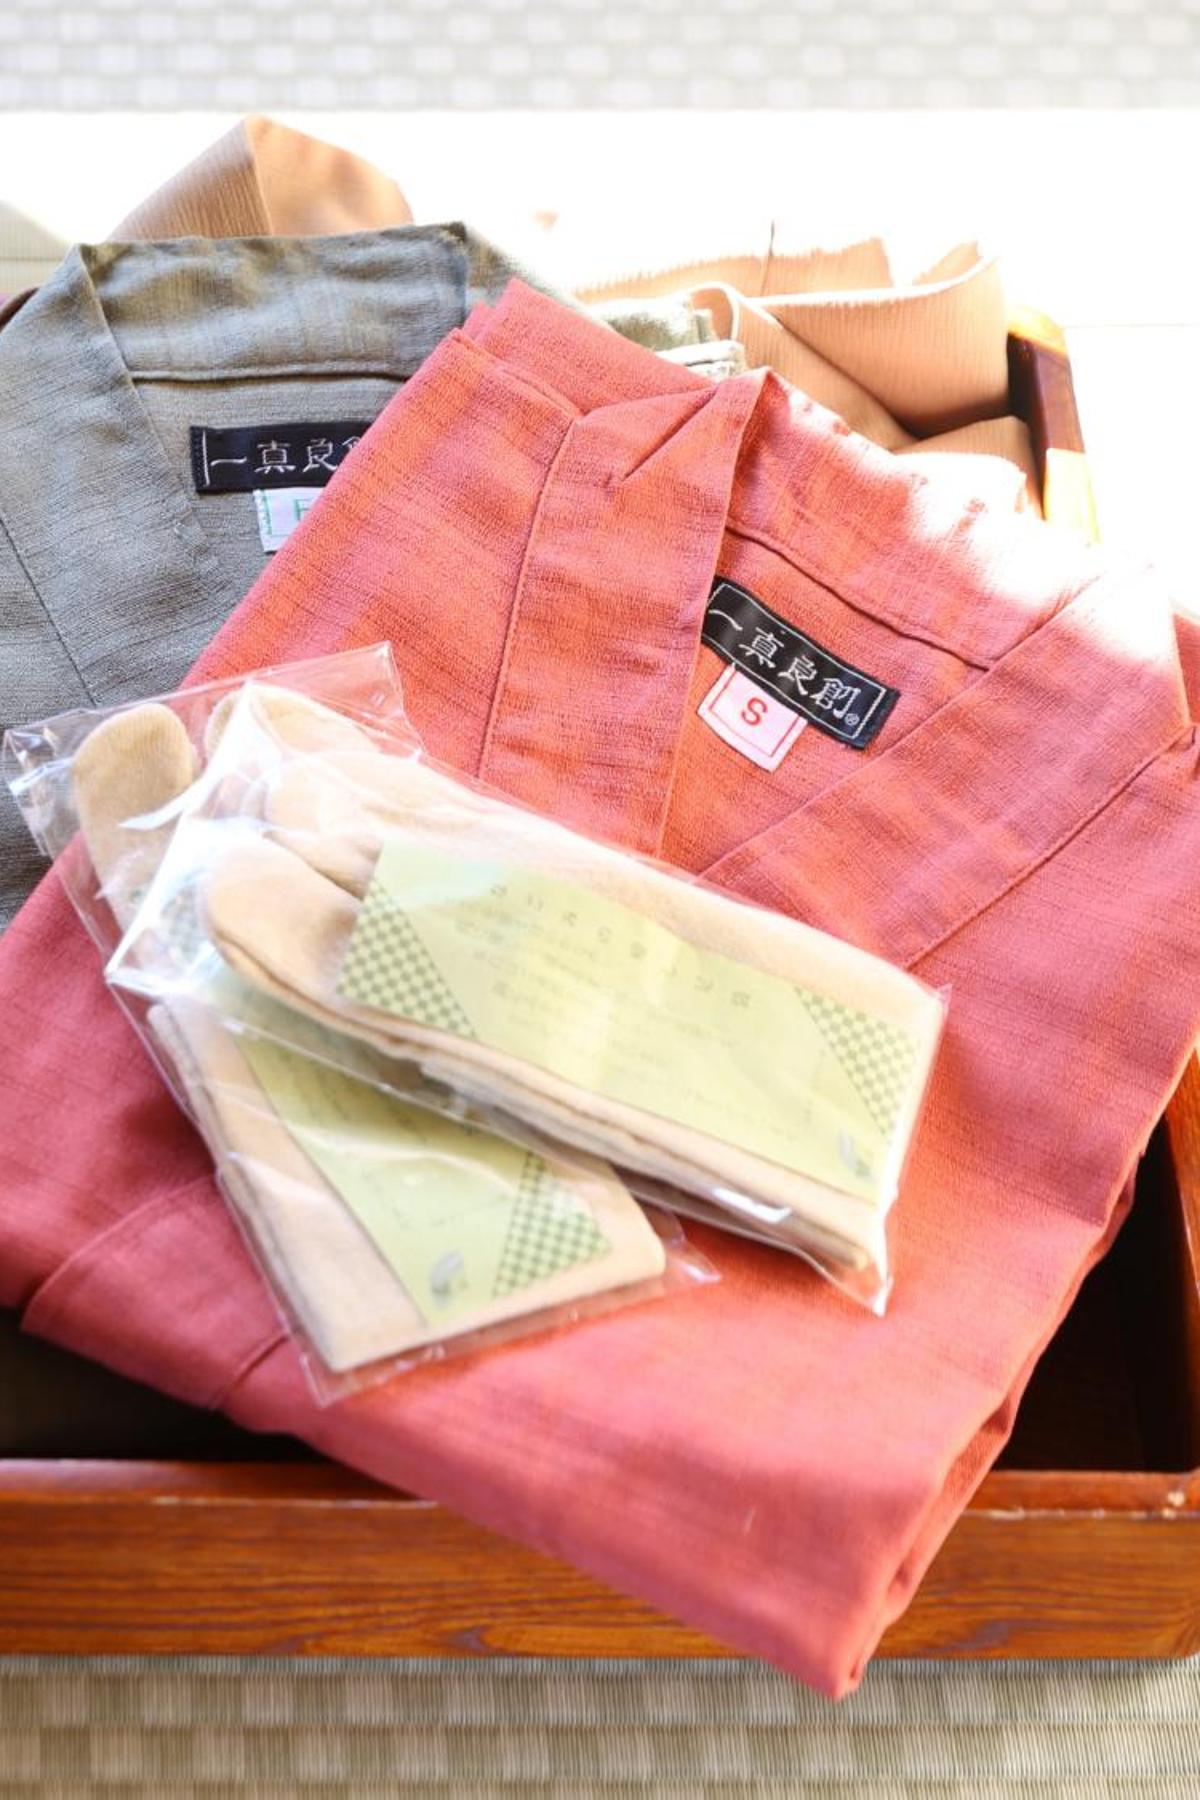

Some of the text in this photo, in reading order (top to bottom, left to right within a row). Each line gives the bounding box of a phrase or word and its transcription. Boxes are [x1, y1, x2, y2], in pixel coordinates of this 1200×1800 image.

[209, 434, 361, 474] 一真良
[740, 697, 768, 727] S
